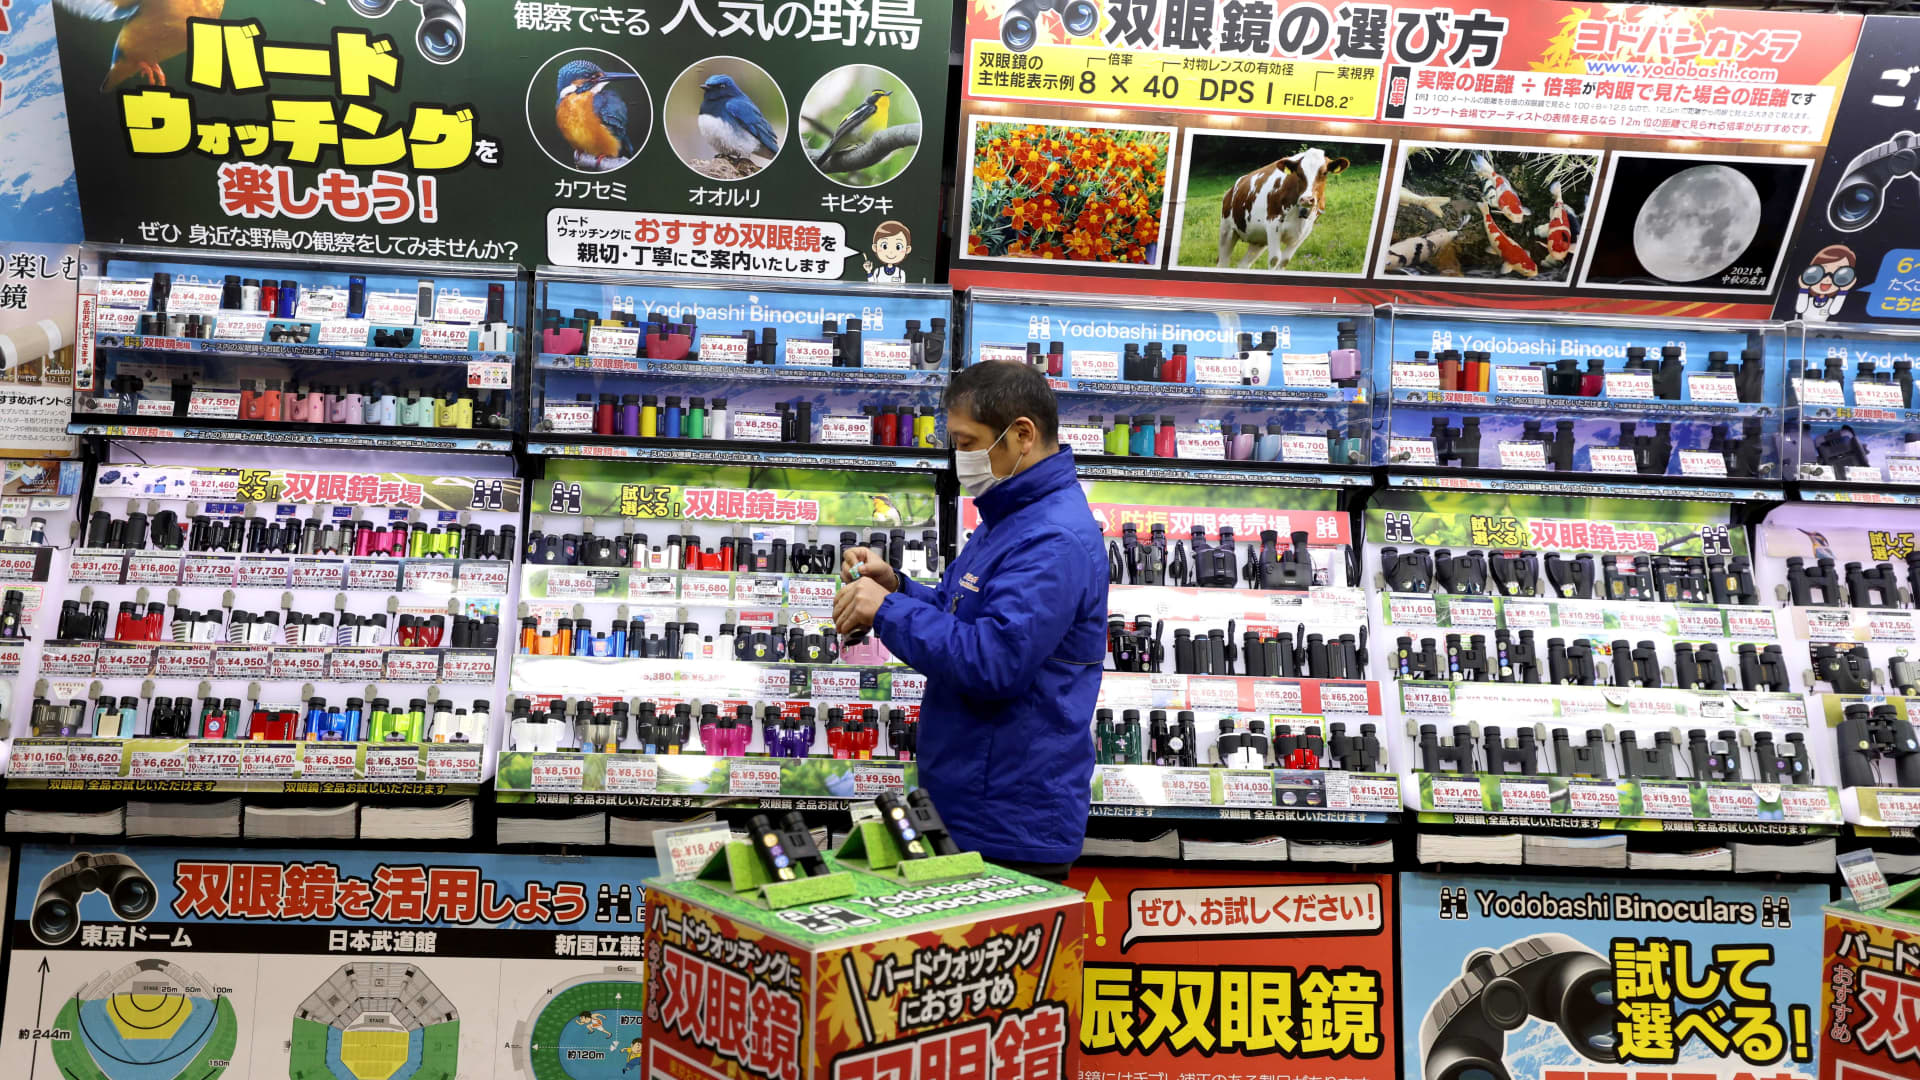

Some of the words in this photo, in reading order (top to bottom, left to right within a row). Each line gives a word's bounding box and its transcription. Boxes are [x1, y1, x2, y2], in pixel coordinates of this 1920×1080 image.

[514, 1, 650, 36] 観察できる
[660, 0, 923, 50] 人気の野鳥
[1104, 0, 1504, 67] 双眼鏡の選び方
[1576, 21, 1800, 62] ヨドバシカメラ
[190, 20, 400, 97] バード
[979, 52, 1044, 71] 双眼鏡の
[1108, 53, 1133, 66] 倍率
[1183, 58, 1294, 77] 対物レンズの有効径
[1337, 66, 1375, 80] 実視界
[1588, 60, 1776, 82] www.yodobashi.com
[977, 71, 1075, 90] 主性能表示例
[1078, 71, 1096, 94] 8
[1143, 76, 1179, 98] 40
[1200, 79, 1254, 103] DPS
[1391, 77, 1405, 106] 倍率
[1417, 70, 1512, 94] 実際の距離
[1544, 77, 1816, 107] 倍率が肉眼で見た場合の距離です
[121, 89, 500, 170] ウォッチングを
[1620, 117, 1641, 127] 12m
[218, 162, 438, 222] 楽しもう!
[554, 179, 628, 201] カワセミ
[688, 187, 760, 207] オオルリ
[821, 193, 894, 212] キビタキ
[557, 214, 589, 226] バード
[557, 227, 631, 241] ウォッチングに
[138, 222, 182, 242] ぜひ
[188, 223, 519, 259] 身近な野鳥の観察をしてみませんか?
[634, 219, 837, 253] おすすめ双眼鏡を
[577, 241, 830, 274] 親切・丁寧にご案内いたします
[1731, 266, 1763, 277] 2021年
[1721, 275, 1766, 287] 中秋の名月
[643, 301, 745, 321] Yodobashi
[143, 337, 191, 350] 双眼鏡売場
[1058, 320, 1157, 339] Yodobashi
[1162, 324, 1263, 343] Binoculs
[1460, 336, 1556, 355] Yodobashi
[1561, 339, 1661, 359] Binocus
[44, 366, 71, 375] Kenko
[282, 472, 423, 505] 双眼鏡売場
[622, 485, 670, 501] 試して
[621, 501, 680, 517] 選べる!
[683, 489, 818, 521] 双眼鏡売場
[1121, 511, 1291, 537] 防振双眼鏡売場
[1470, 516, 1516, 531] 試して
[1472, 531, 1528, 546] 選べる!
[1529, 520, 1658, 551] 双眼鏡売場
[1869, 531, 1914, 547] 試して
[87, 780, 215, 791] 全品お試しいただけます
[322, 782, 446, 795] 全品お試しいただけます
[573, 795, 693, 807] 全品お試しいただけます
[760, 800, 792, 809] 双眼鏡
[1254, 810, 1367, 822] 全品お試しいただけます
[1488, 815, 1600, 828] 全品お試しいただけます
[1697, 823, 1808, 834] 全品お試しいただけます
[174, 862, 587, 922] 双眼鏡を活用しよう
[852, 875, 1015, 909] Yodobashi
[878, 883, 1049, 919] Binoculars
[1476, 891, 1610, 920] Yodobashi
[1614, 896, 1755, 923] Binoculars
[1138, 893, 1374, 927] ぜひ、お試しください!
[81, 925, 192, 947] 東京ドーム
[328, 930, 437, 953] 日本武道館
[652, 906, 801, 985] バードウォッチングに
[872, 927, 1043, 999] バードウォッチング
[1614, 942, 1773, 1001] 試して
[660, 944, 801, 1080] 双眼鏡
[901, 975, 1016, 1027] におすすめ
[1831, 964, 1854, 1043] おすすめ
[1615, 1002, 1809, 1060] 選べる!
[567, 1050, 604, 1060] 約120m
